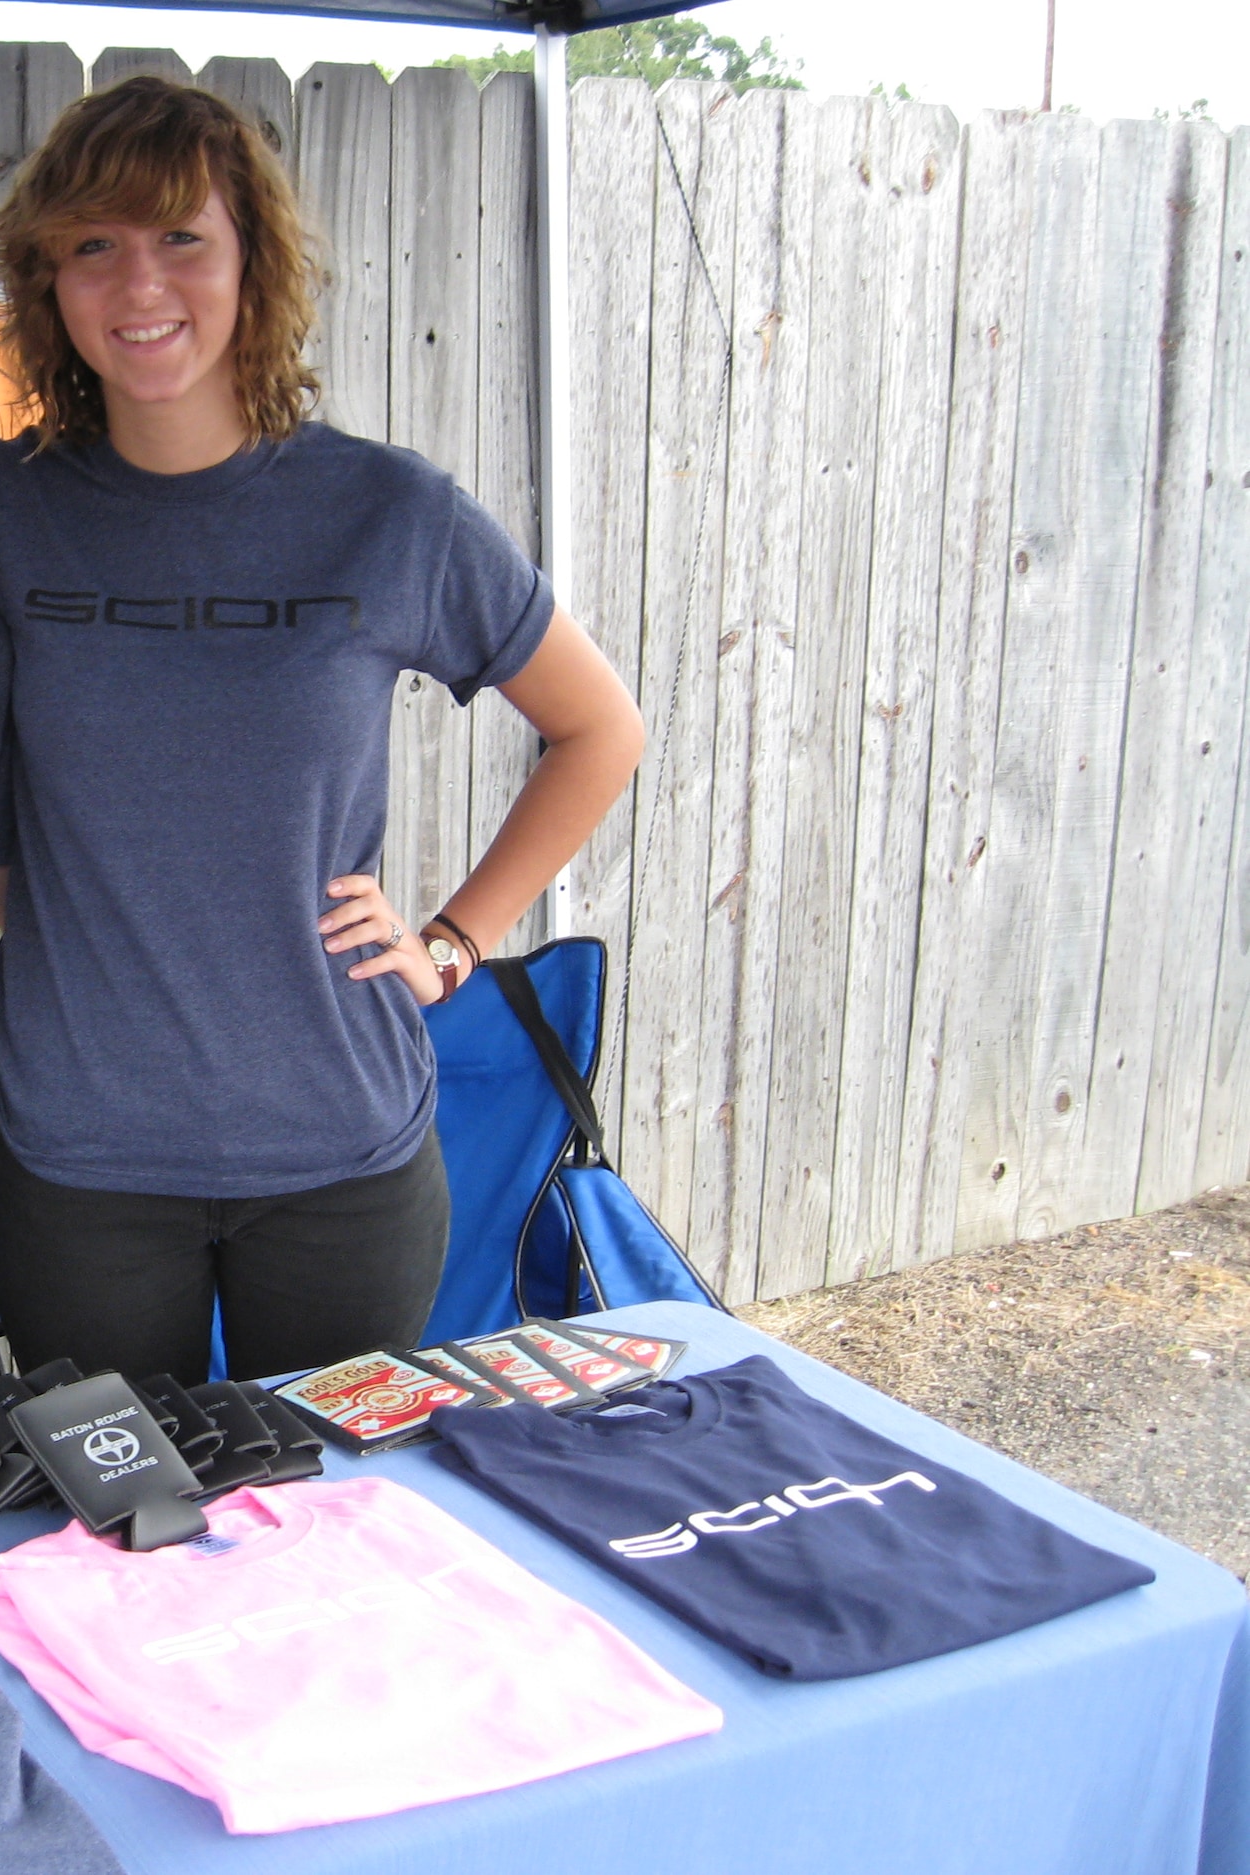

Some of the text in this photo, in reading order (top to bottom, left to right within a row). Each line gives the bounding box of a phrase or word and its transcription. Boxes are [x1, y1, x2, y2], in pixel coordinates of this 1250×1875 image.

[24, 588, 361, 631] SCION
[344, 1360, 390, 1379] GOLD
[49, 1405, 140, 1442] BATON ROUGE
[98, 1455, 159, 1483] DEALERS
